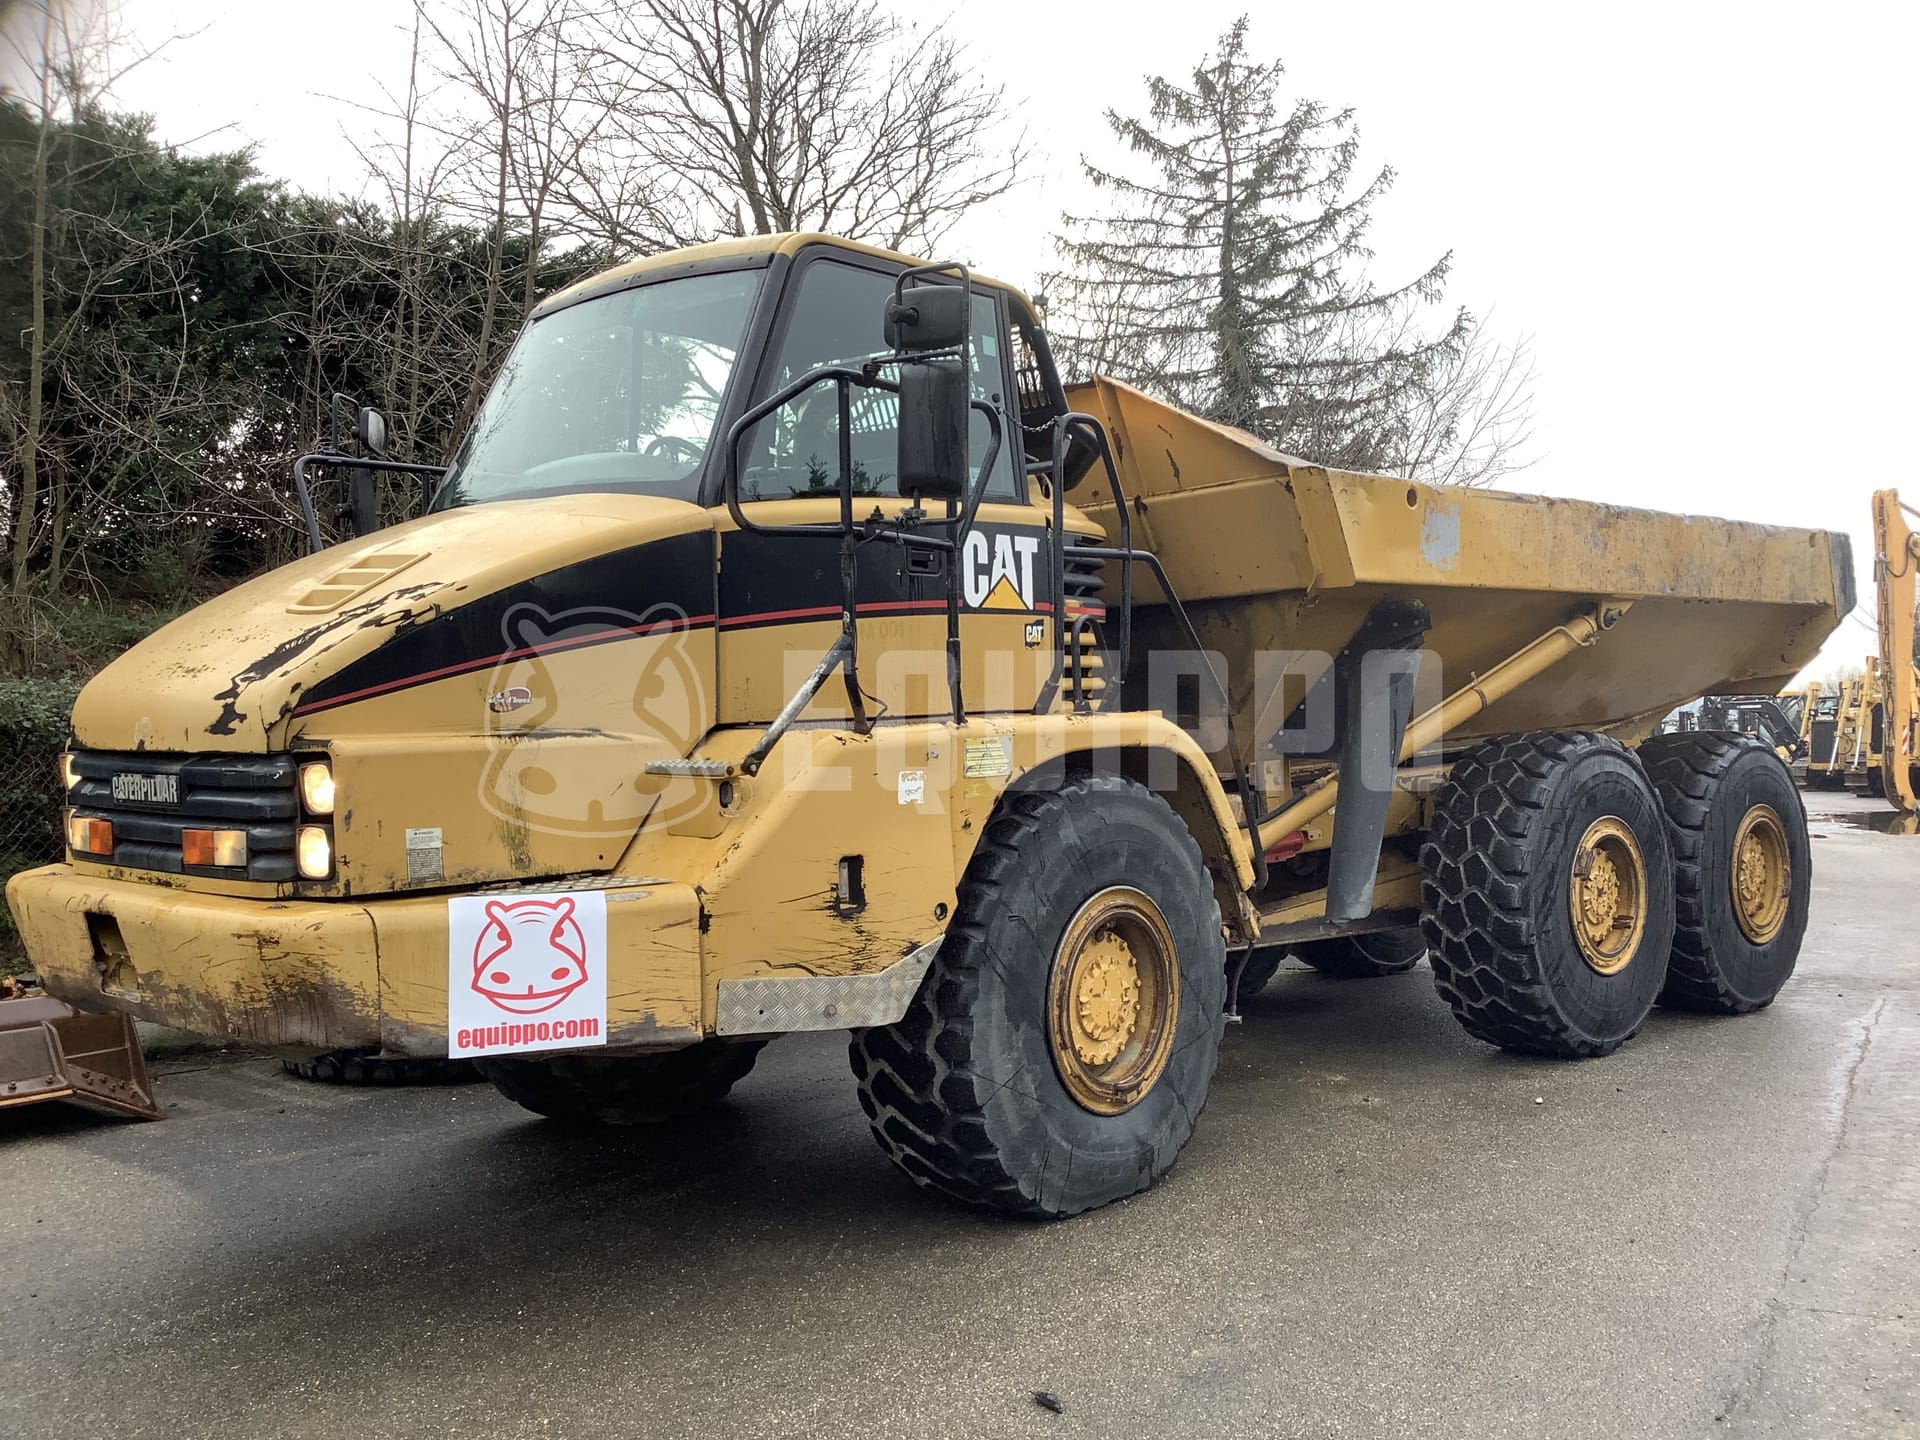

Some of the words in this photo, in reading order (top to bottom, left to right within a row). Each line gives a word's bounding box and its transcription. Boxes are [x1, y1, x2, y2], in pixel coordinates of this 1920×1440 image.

[963, 530, 1037, 610] CAT
[1026, 625, 1043, 643] CAT
[112, 775, 178, 803] CATERPILLAR
[457, 1018, 599, 1049] equippo.com
